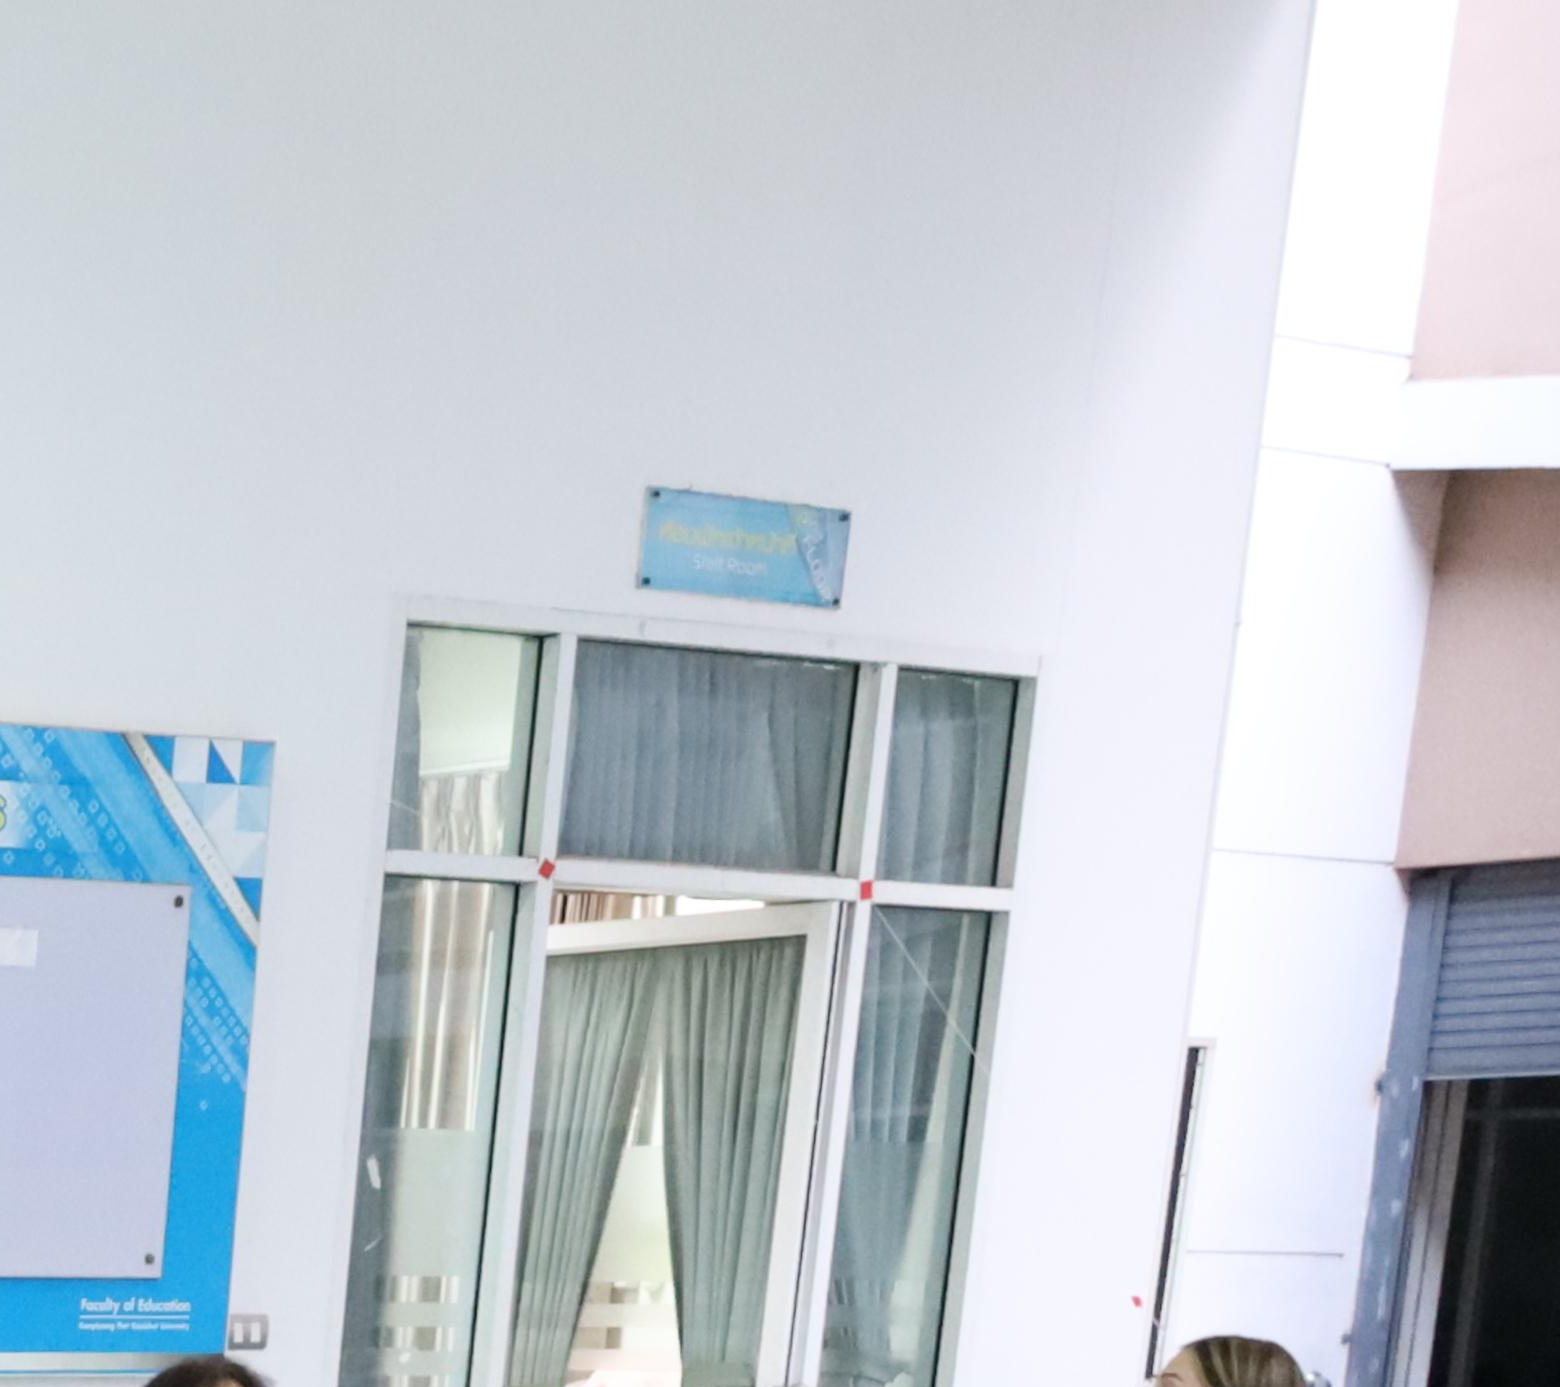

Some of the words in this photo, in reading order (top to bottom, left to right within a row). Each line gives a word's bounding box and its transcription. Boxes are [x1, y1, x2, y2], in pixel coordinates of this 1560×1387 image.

[80, 1297, 120, 1315] Faculty
[122, 1296, 136, 1312] of
[137, 1297, 192, 1313] Education
